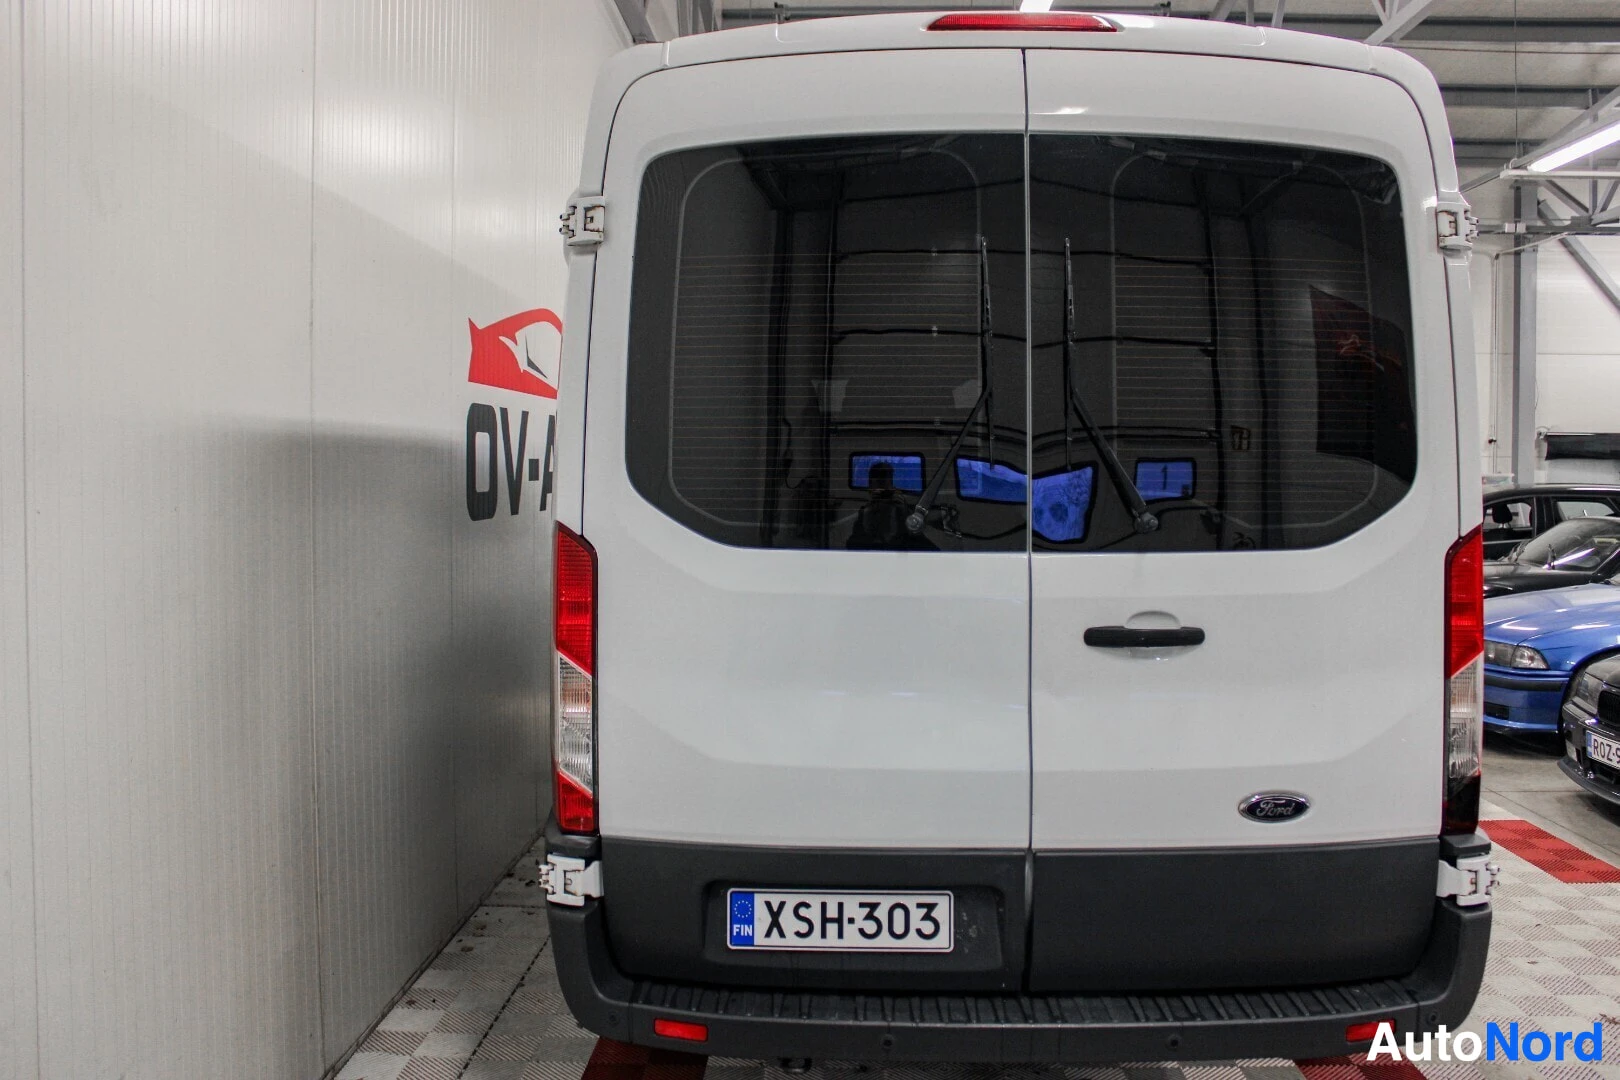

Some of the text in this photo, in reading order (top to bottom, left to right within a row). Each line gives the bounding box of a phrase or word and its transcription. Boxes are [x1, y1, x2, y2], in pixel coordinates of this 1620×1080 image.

[1256, 800, 1296, 816] Ford
[764, 900, 941, 940] XSH-303
[733, 924, 753, 937] FIN
